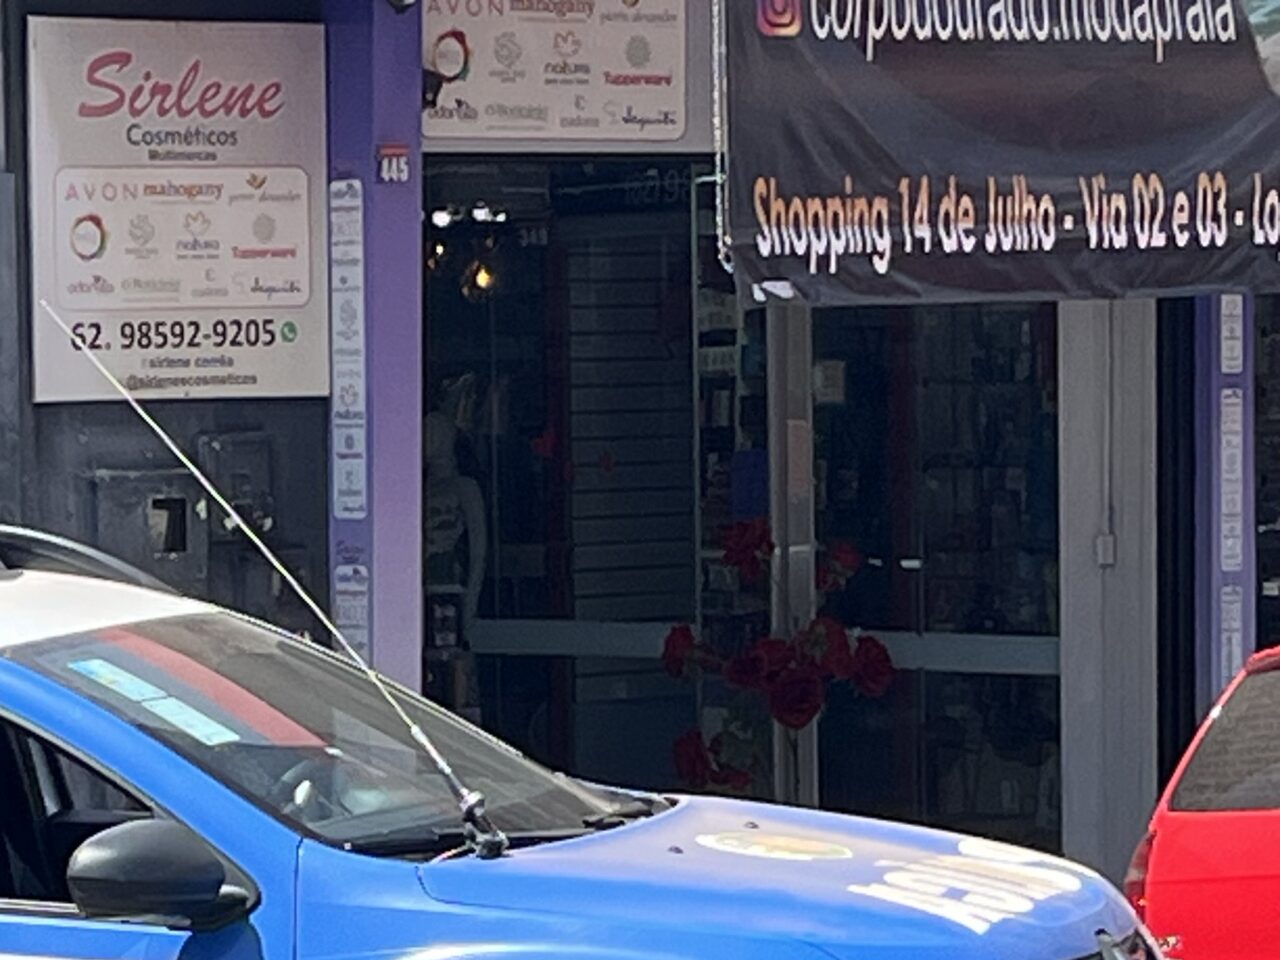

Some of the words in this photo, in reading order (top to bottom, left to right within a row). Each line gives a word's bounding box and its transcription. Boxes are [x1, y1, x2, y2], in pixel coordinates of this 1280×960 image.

[78, 51, 286, 121] Sirlene
[126, 123, 239, 148] Cosméticos
[380, 156, 410, 183] 445
[65, 182, 139, 201] AVON
[754, 174, 892, 275] Shopping
[897, 174, 932, 254] 14
[938, 174, 977, 254] de
[985, 173, 1056, 252] Julho
[1078, 173, 1128, 250] Via
[1133, 172, 1167, 249] 02
[1172, 190, 1190, 248] e
[1195, 170, 1228, 248] 03
[1252, 172, 1280, 254] Lo
[120, 318, 277, 350] 98592-9205
